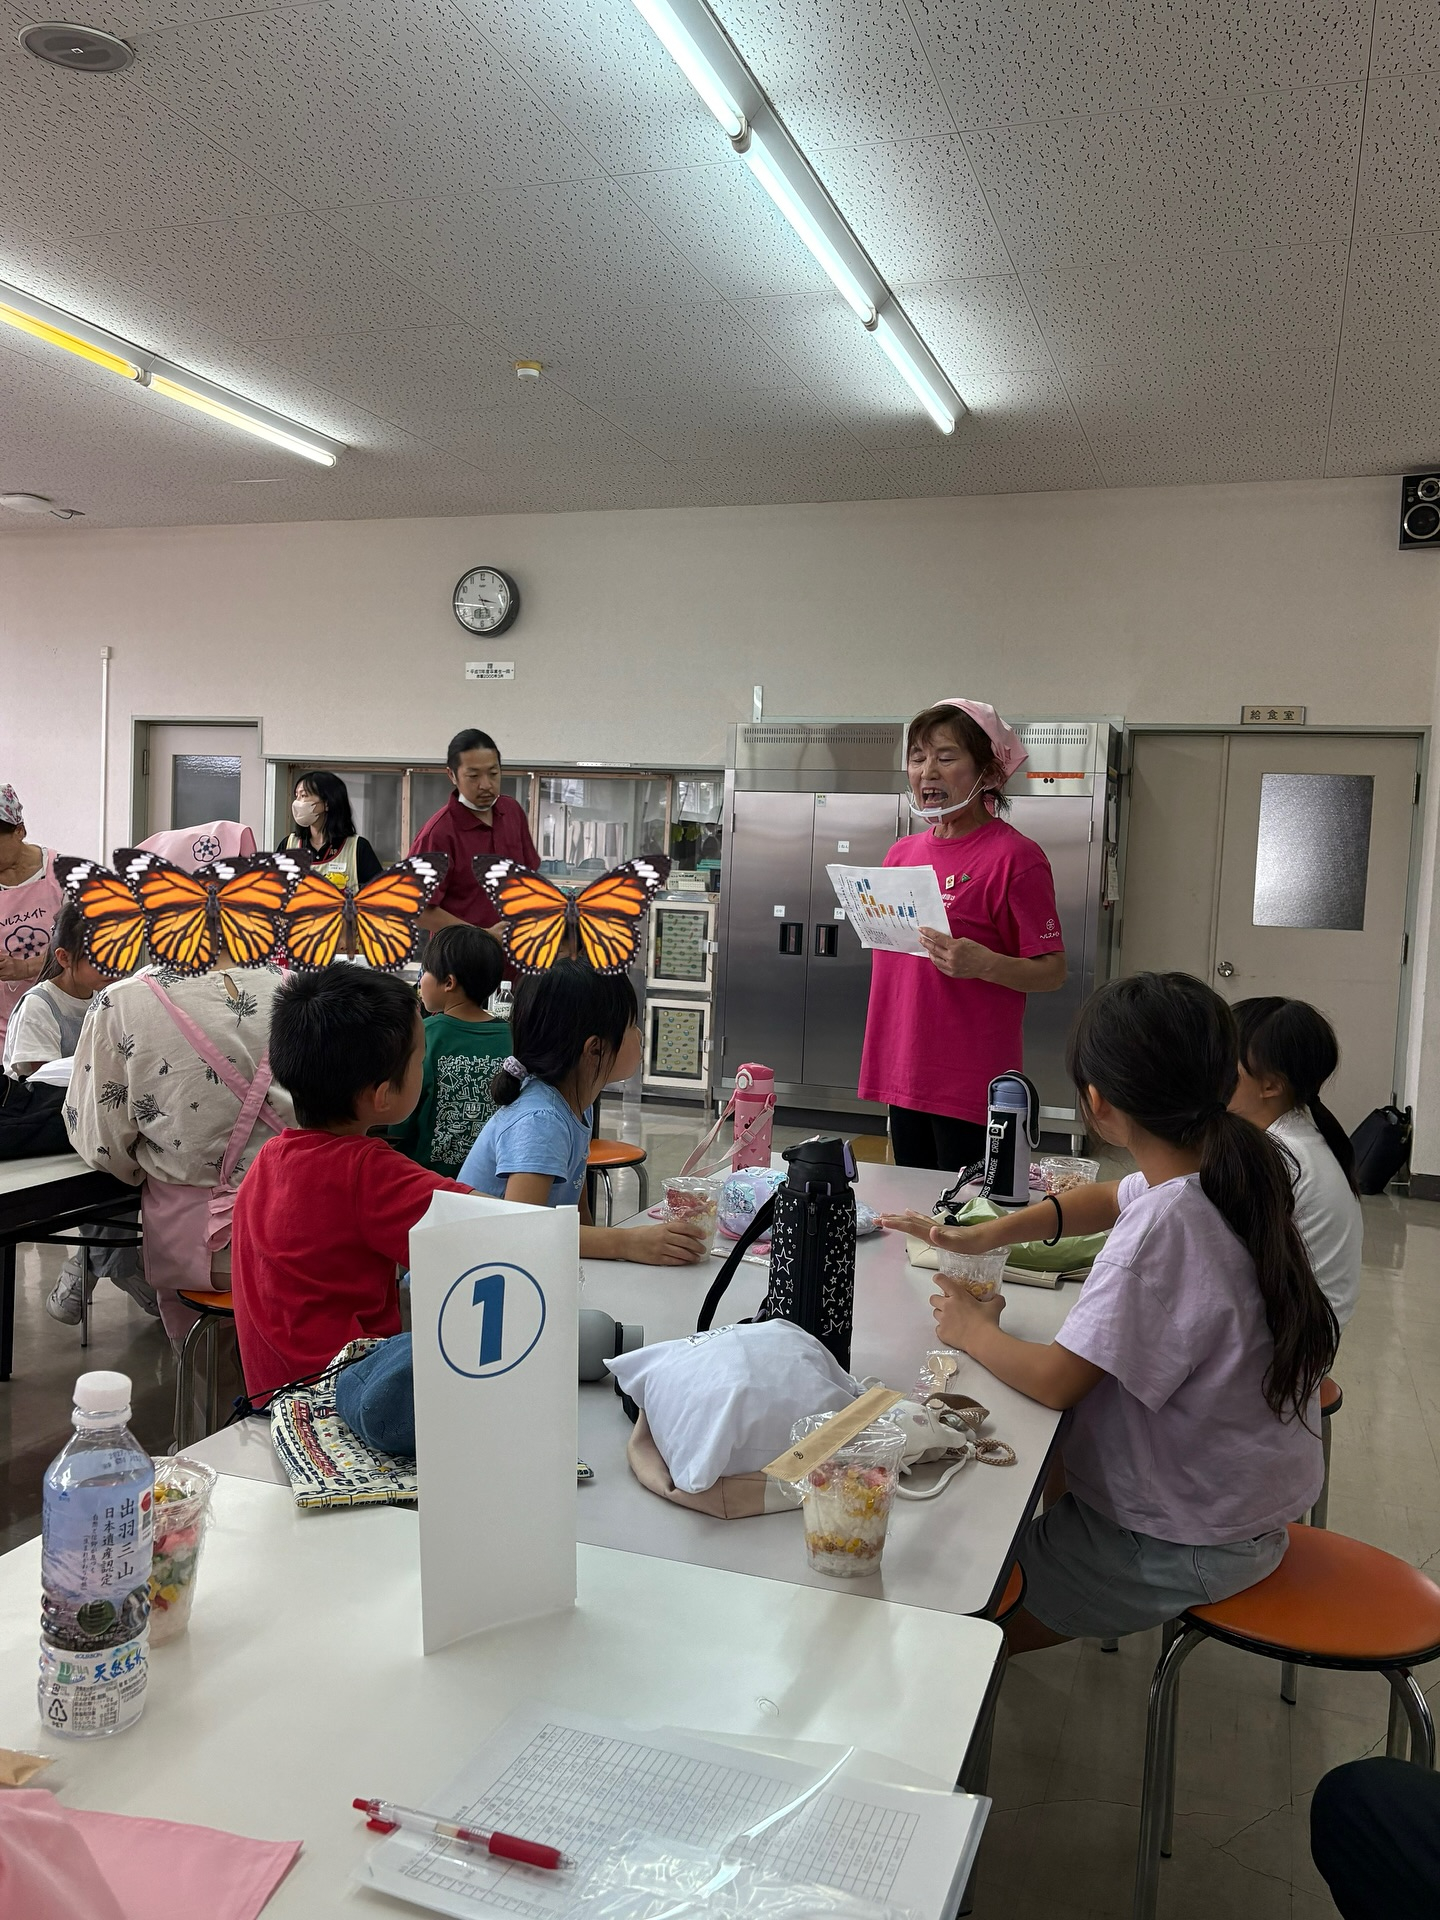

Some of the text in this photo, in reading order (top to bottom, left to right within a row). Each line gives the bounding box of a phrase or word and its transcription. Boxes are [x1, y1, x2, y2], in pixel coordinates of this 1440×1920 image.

[462, 585, 468, 594] 10
[480, 573, 486, 581] 12
[1249, 709, 1295, 721] 給食室
[986, 1157, 998, 1185] CHARGE
[100, 1506, 116, 1587] 日本遺産認定
[117, 1497, 135, 1579] 出羽三山
[93, 1648, 146, 1684] 天然名水
